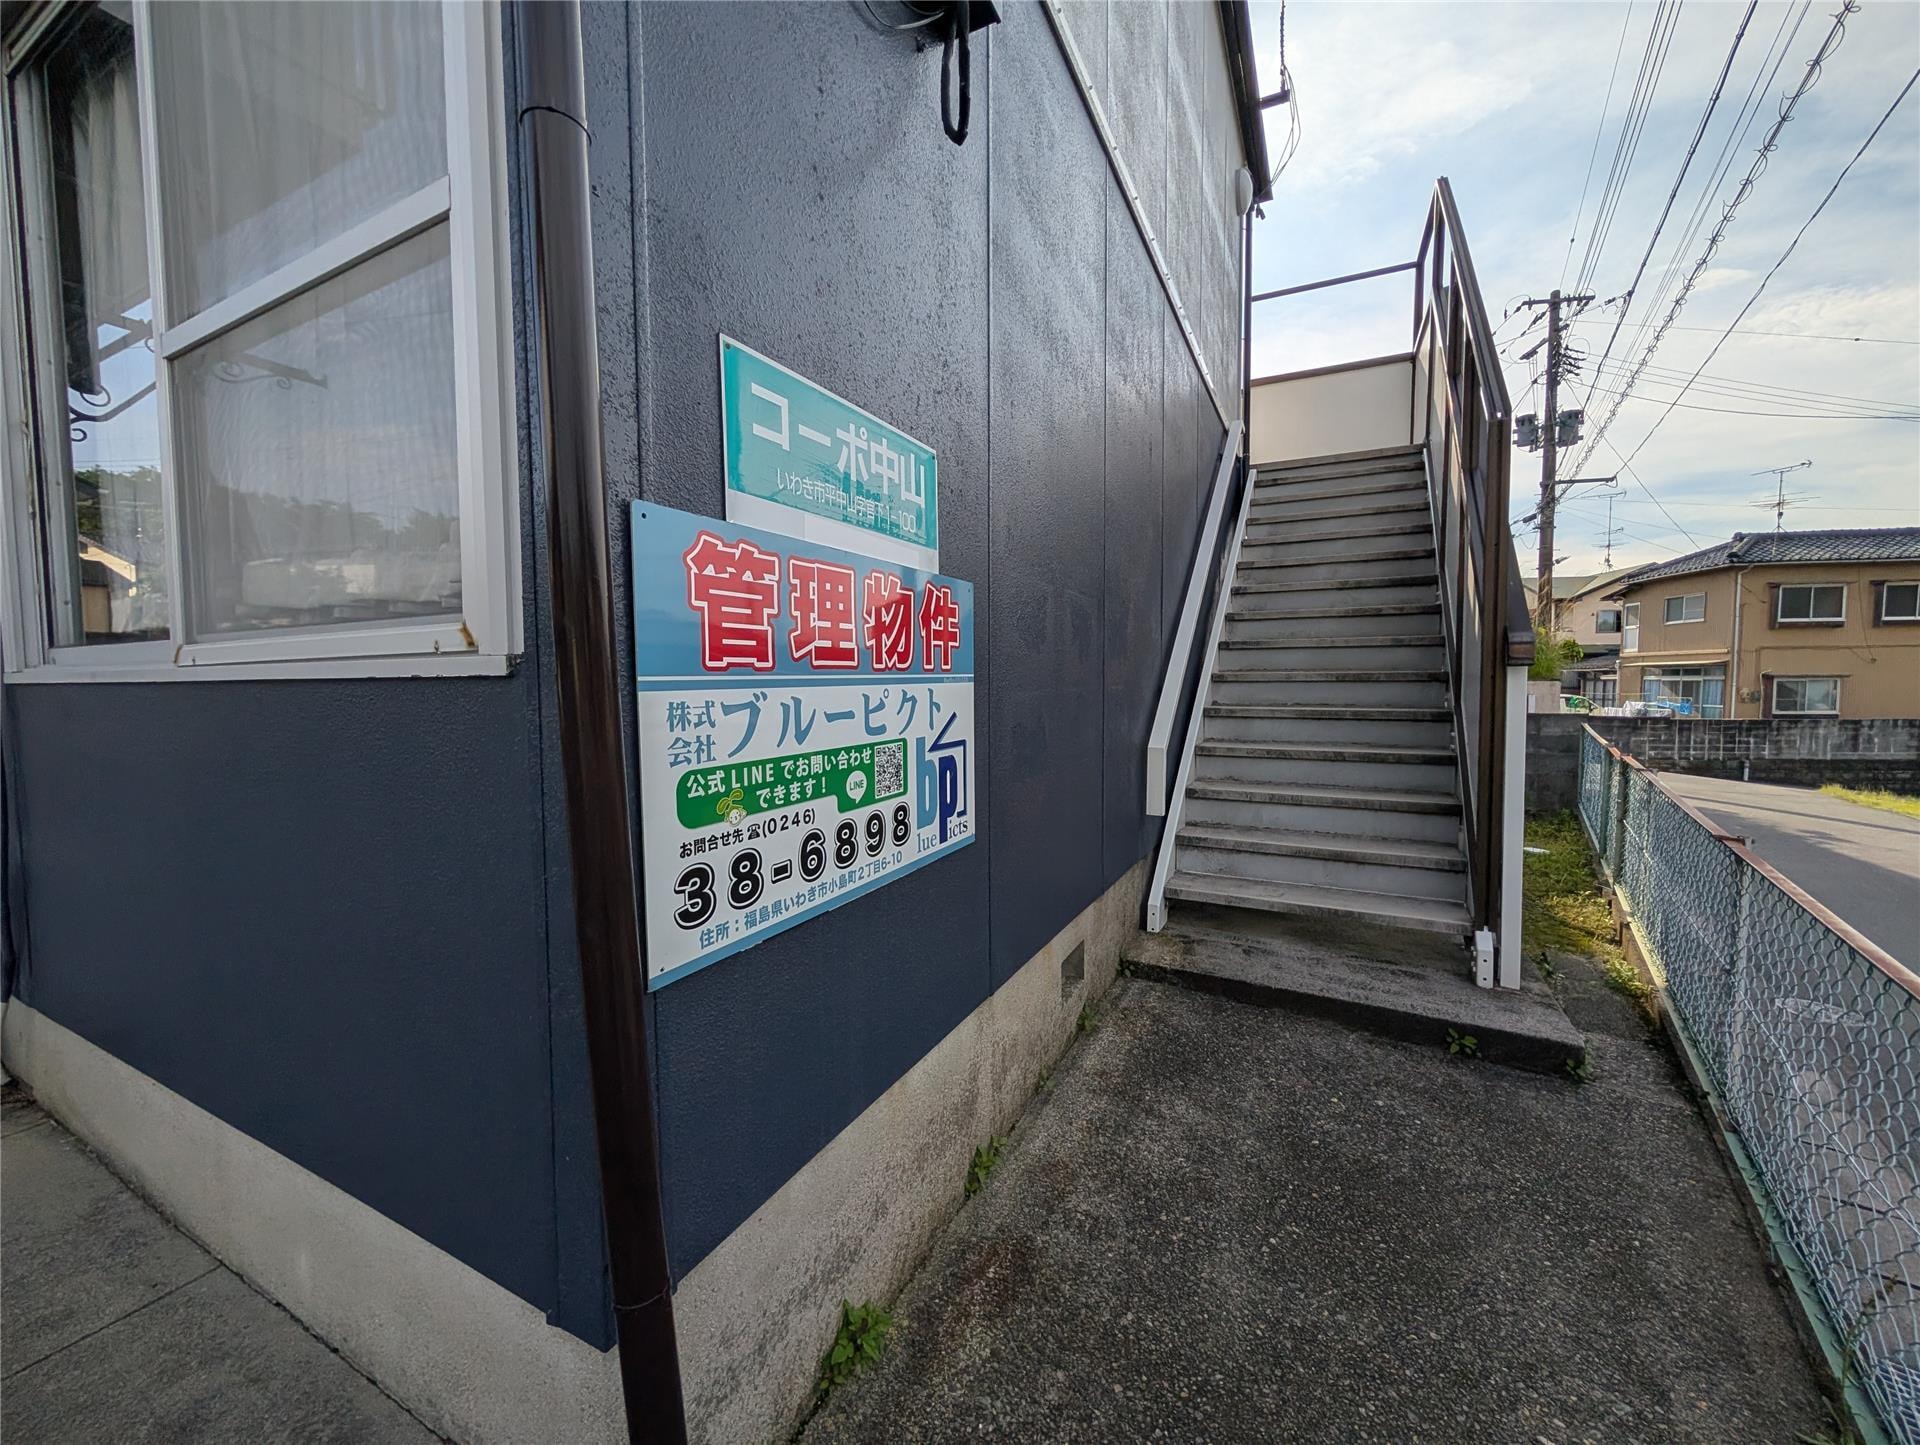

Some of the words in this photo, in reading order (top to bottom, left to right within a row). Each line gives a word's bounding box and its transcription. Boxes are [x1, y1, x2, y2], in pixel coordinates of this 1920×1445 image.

[751, 382, 926, 508] コーポ中山
[683, 530, 961, 672] 管理物件
[720, 688, 942, 759] ブルーピクト
[756, 776, 826, 809] できます！
[849, 779, 865, 791] LINE
[673, 802, 912, 931] 38-6898
[679, 828, 744, 859] お問合せ先
[762, 808, 816, 838] (0246)
